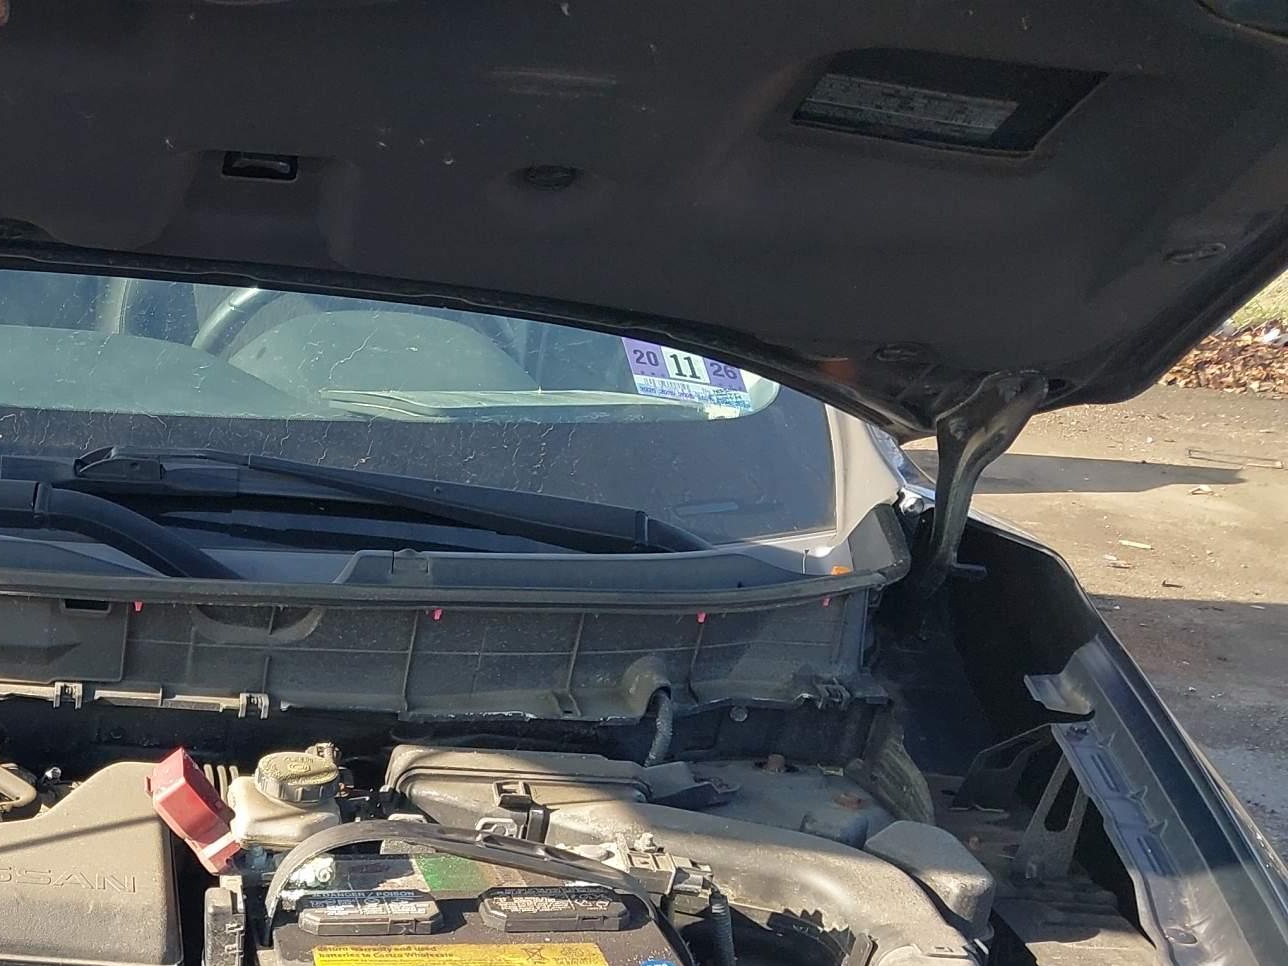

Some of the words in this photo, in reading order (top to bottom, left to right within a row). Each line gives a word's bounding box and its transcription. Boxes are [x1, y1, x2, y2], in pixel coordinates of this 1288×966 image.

[633, 349, 659, 366] 20
[670, 354, 701, 380] 11
[709, 362, 738, 380] 26
